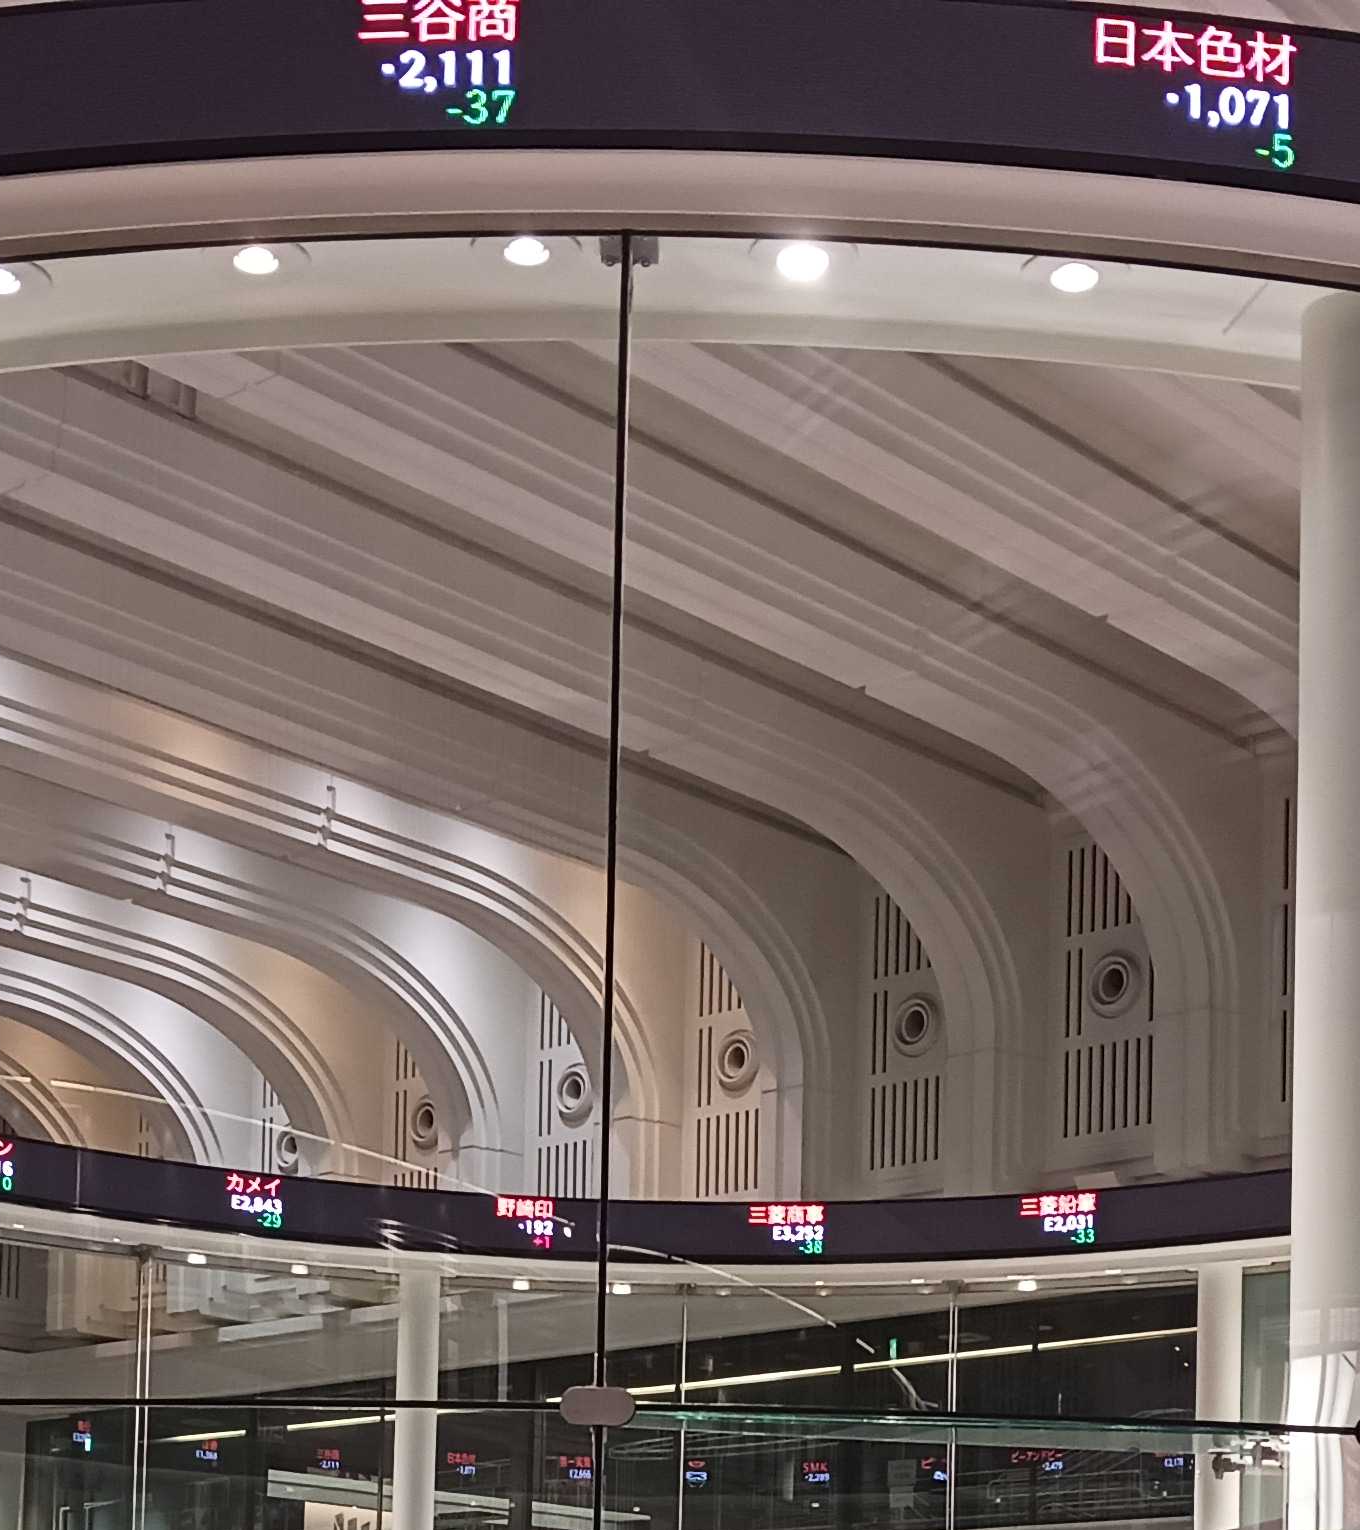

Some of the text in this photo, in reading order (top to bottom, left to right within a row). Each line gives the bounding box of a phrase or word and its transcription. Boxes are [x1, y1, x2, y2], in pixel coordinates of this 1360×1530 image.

[358, 0, 517, 42] 三谷商
[1096, 17, 1297, 85] 日本色材
[445, 88, 516, 124] -37
[1255, 133, 1294, 168] -5
[226, 1172, 281, 1197] カメイ
[748, 1204, 825, 1225] 三菱商事
[1020, 1193, 1097, 1217] 三菱鉛筆
[256, 1212, 282, 1229] -29
[798, 1240, 823, 1254] -38
[1070, 1228, 1095, 1243] -33
